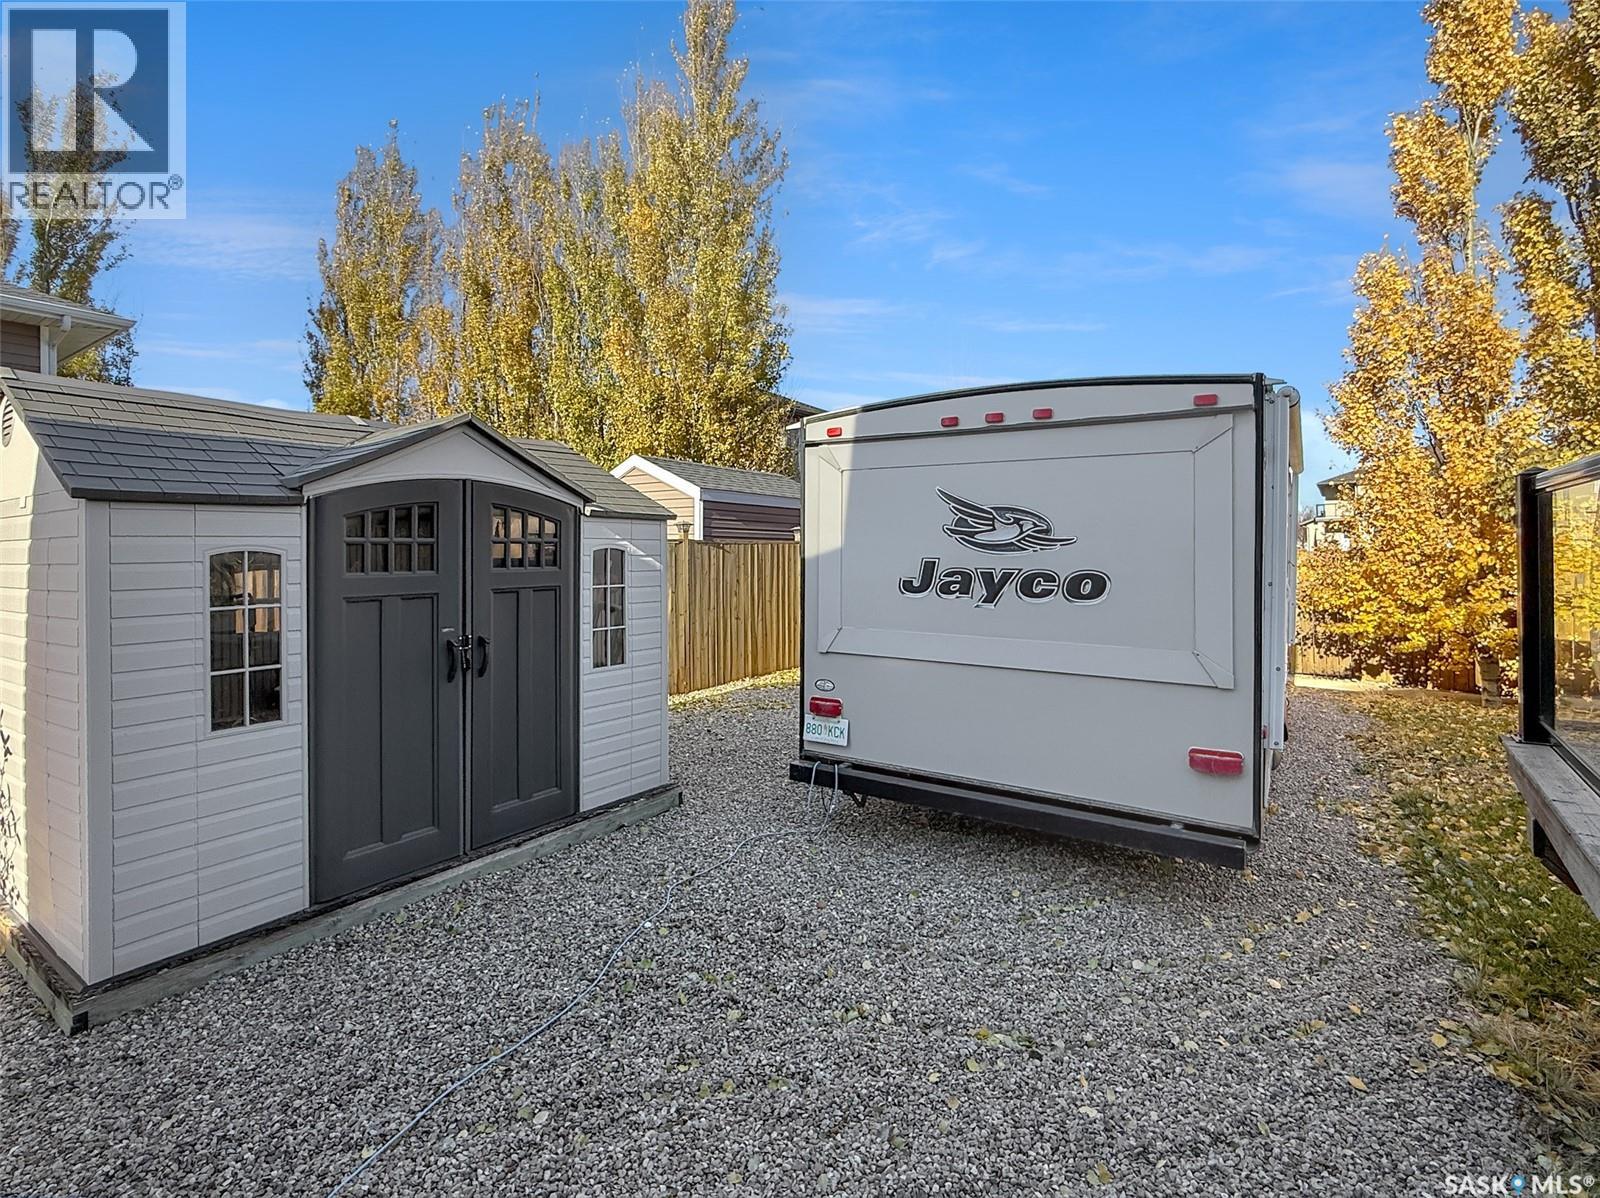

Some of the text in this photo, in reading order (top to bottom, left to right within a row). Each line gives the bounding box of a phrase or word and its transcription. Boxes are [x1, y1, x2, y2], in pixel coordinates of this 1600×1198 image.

[899, 557, 1112, 609] Jayco
[805, 722, 823, 736] 880
[827, 725, 846, 739] KCK
